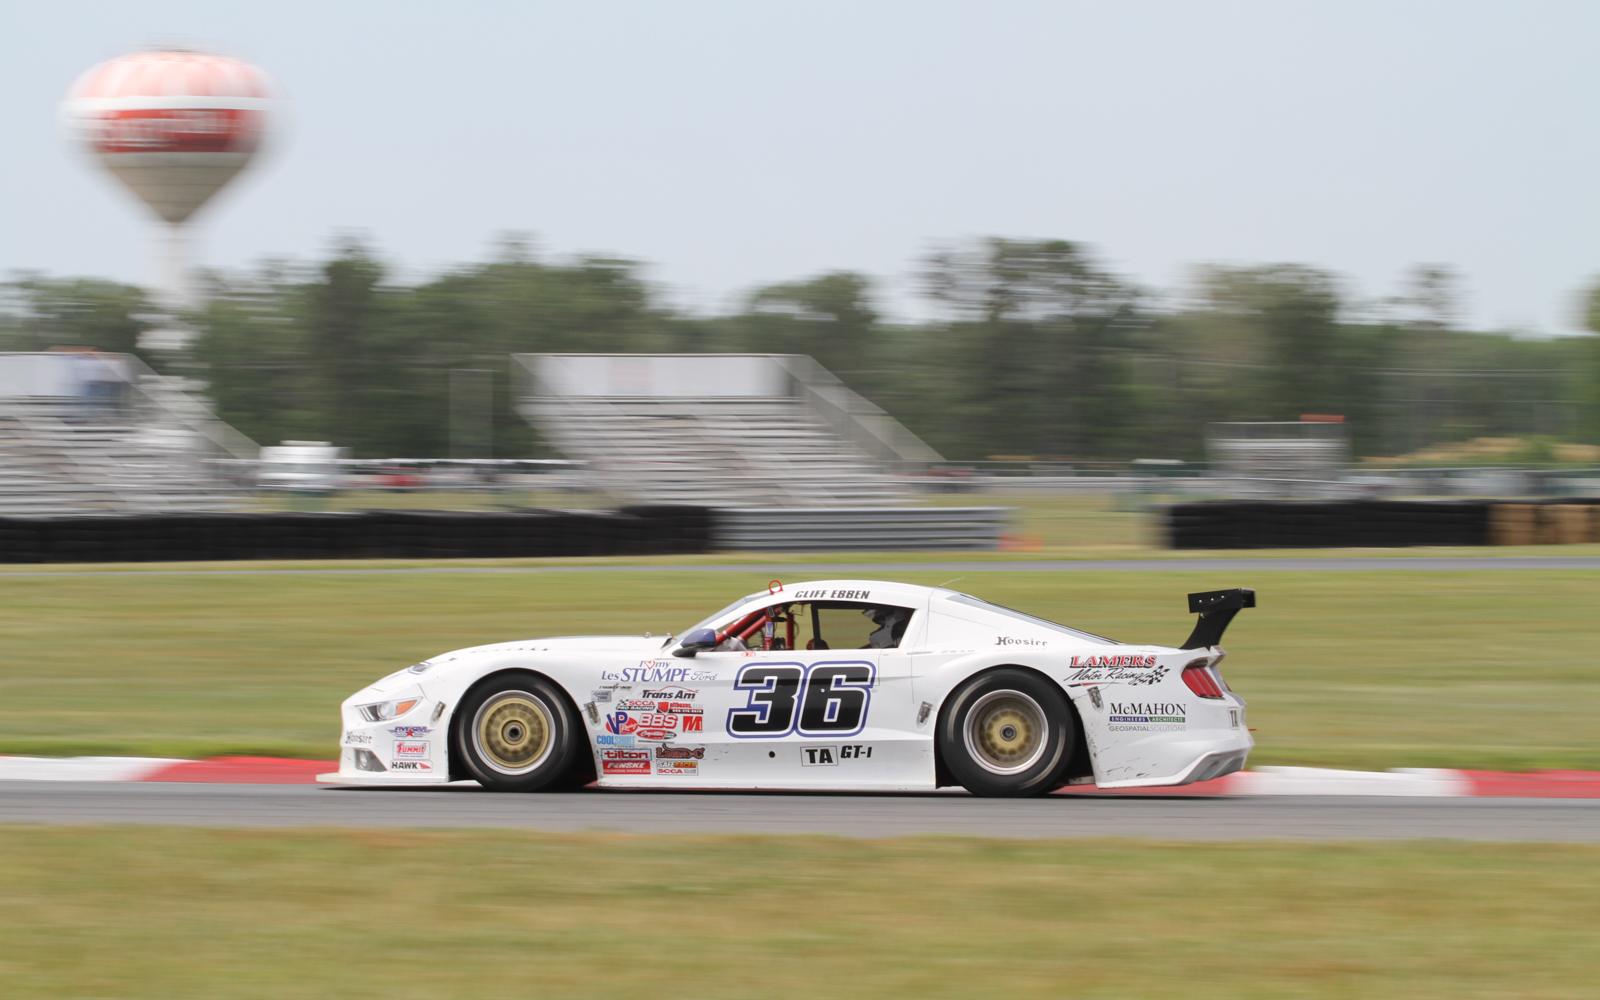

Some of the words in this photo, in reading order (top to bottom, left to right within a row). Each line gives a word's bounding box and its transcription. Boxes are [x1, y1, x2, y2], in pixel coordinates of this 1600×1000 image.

[795, 590, 826, 598] CLIFF
[830, 590, 870, 599] EBBEN
[1070, 655, 1157, 669] LAMERS
[602, 670, 619, 680] Les
[621, 667, 691, 682] STUMPF
[1064, 668, 1102, 681] Motor
[1104, 668, 1148, 685] Racing
[642, 690, 673, 699] Trans
[675, 690, 696, 699] Am
[726, 660, 876, 739] 36
[1110, 703, 1186, 715] McMAHON
[606, 712, 628, 735] VP
[640, 713, 678, 729] BBS
[604, 751, 648, 759] tilton
[805, 749, 833, 763] TA
